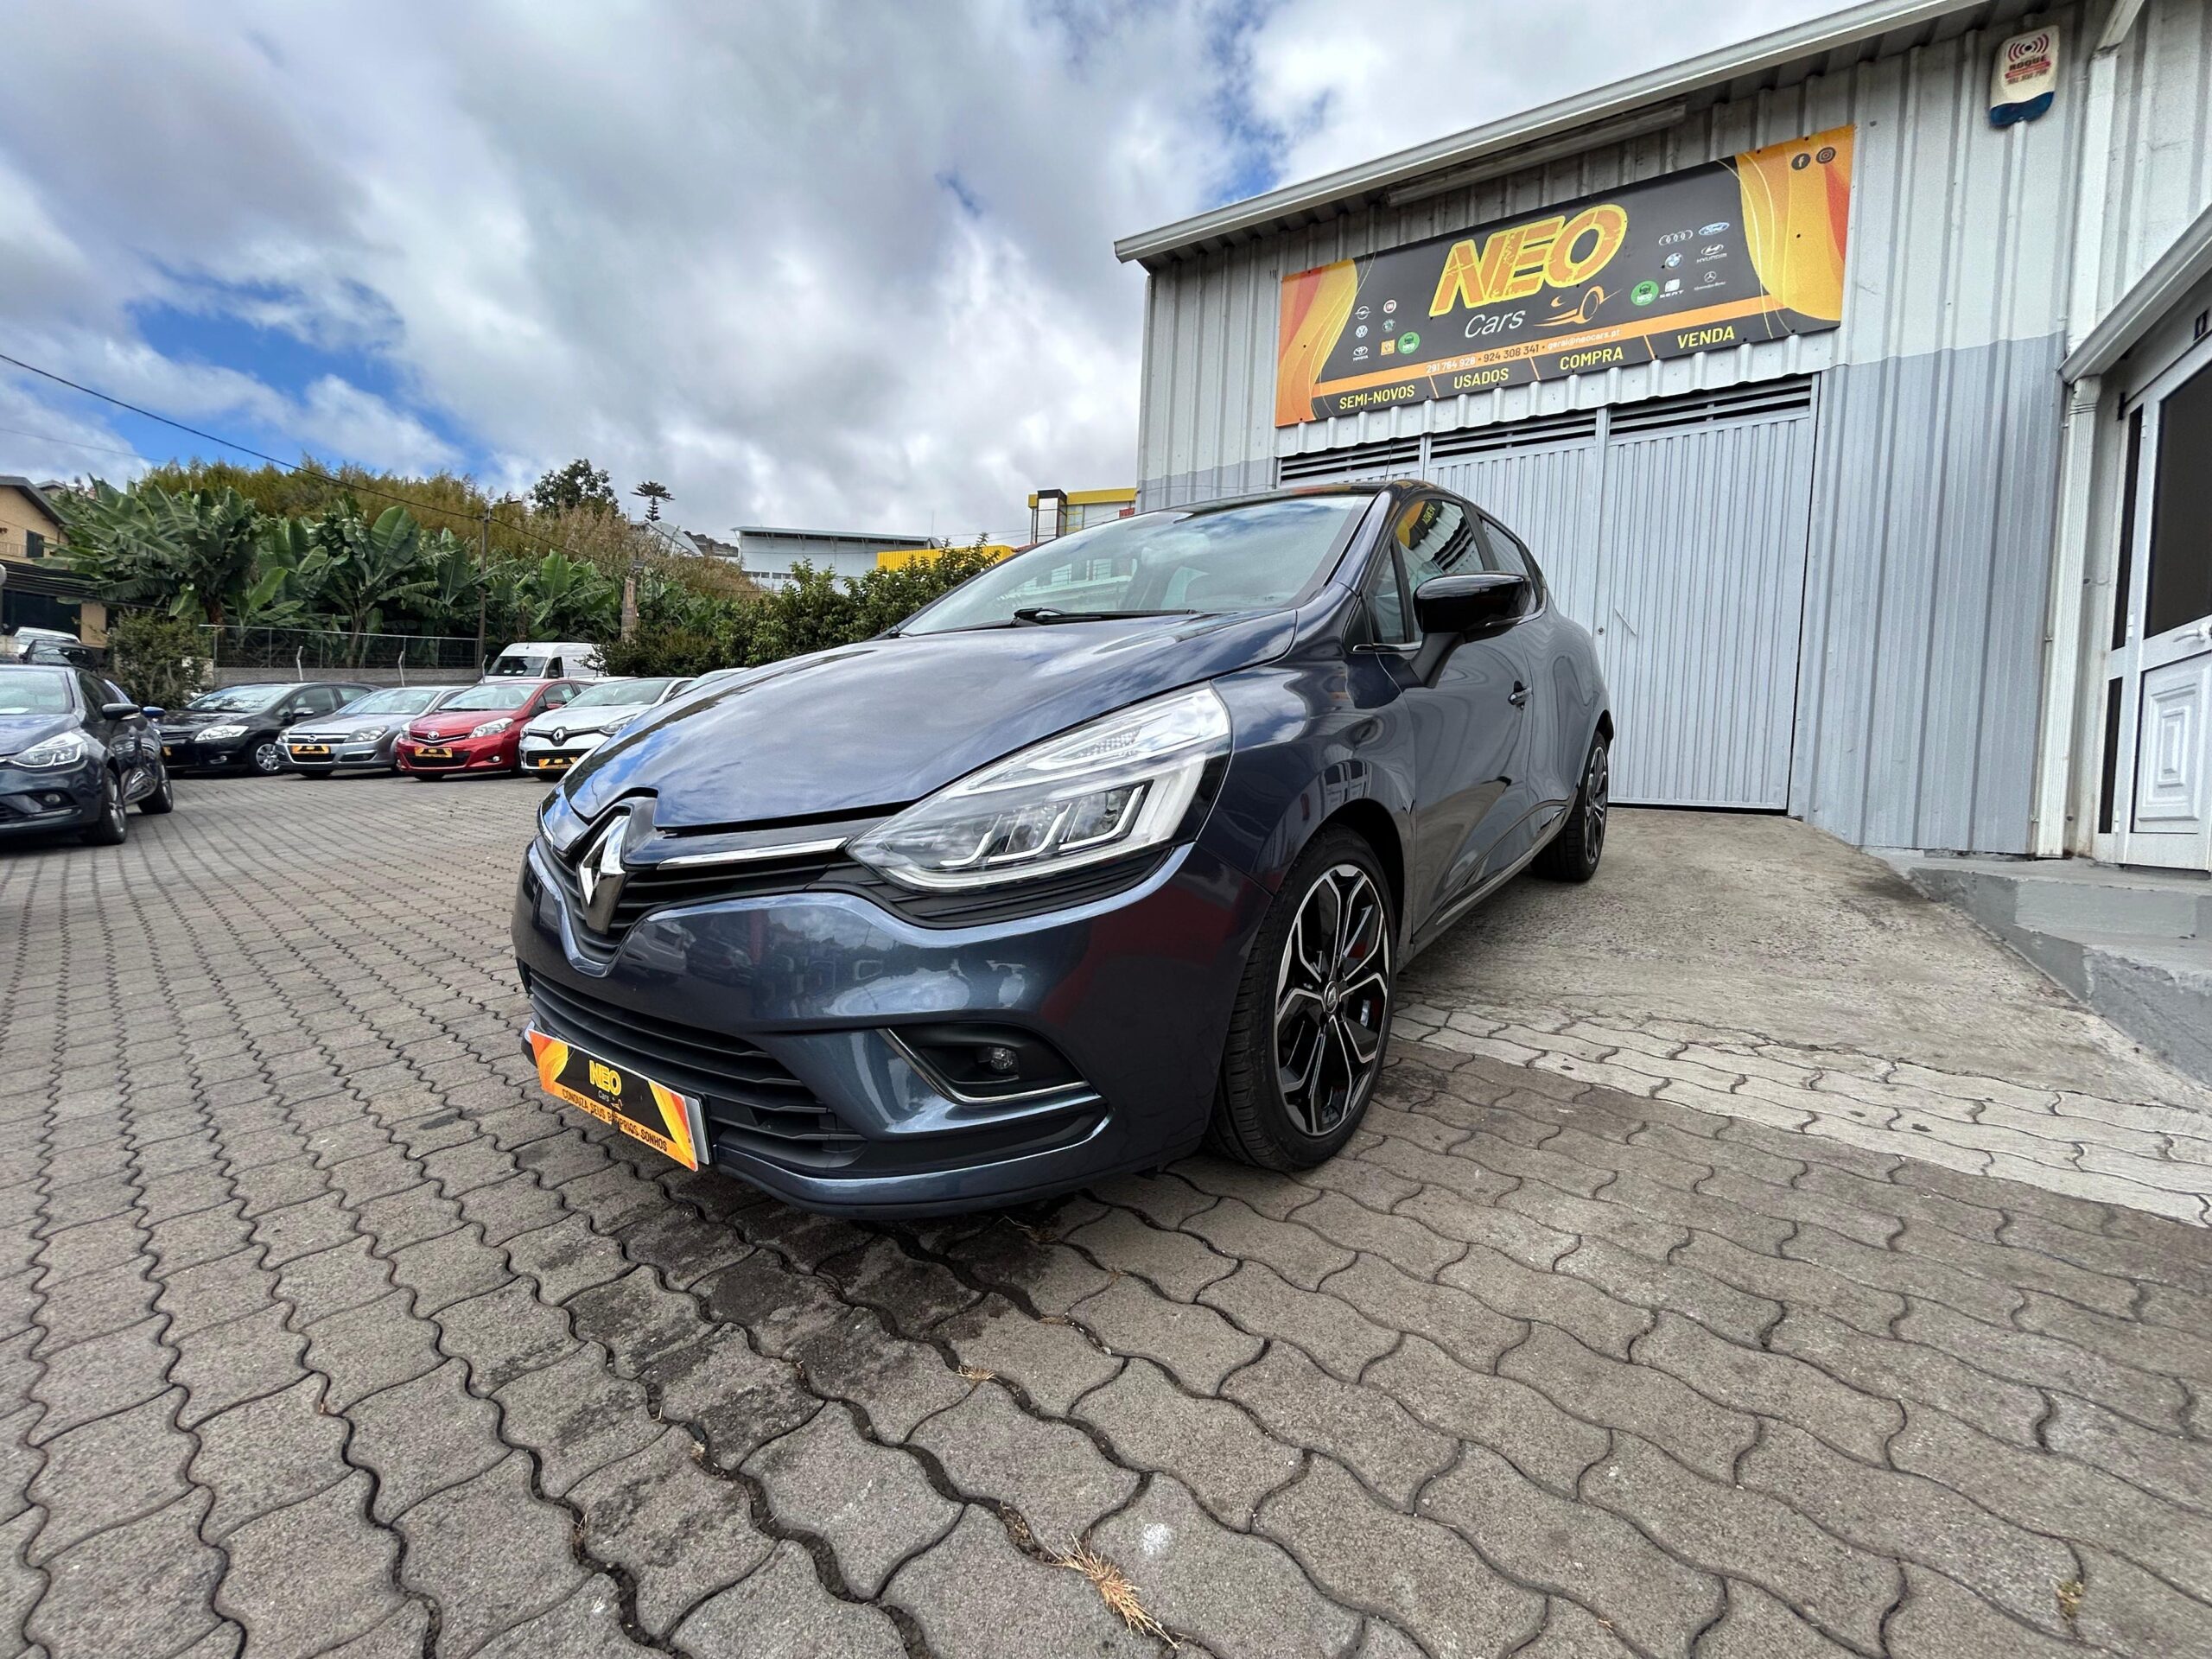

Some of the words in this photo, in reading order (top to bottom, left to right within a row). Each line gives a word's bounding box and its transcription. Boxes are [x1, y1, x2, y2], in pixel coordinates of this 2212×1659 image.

[1428, 203, 1628, 317] NEO
[1465, 309, 1527, 339] Cars
[1339, 385, 1415, 410] SEMI-NOVOS
[1453, 367, 1510, 389] USADOS
[1560, 346, 1624, 371] COMPRA
[1677, 326, 1735, 349] VENDA
[1426, 362, 1440, 373] 291
[1459, 357, 1476, 368] 928
[1484, 352, 1502, 363] 924
[1503, 347, 1522, 359] 308
[1523, 344, 1540, 355] 341
[1548, 328, 1621, 351] geral@neocars.pt
[589, 1059, 622, 1096] NEO
[598, 1090, 610, 1103] Cars
[640, 1128, 667, 1153] SONHOS
